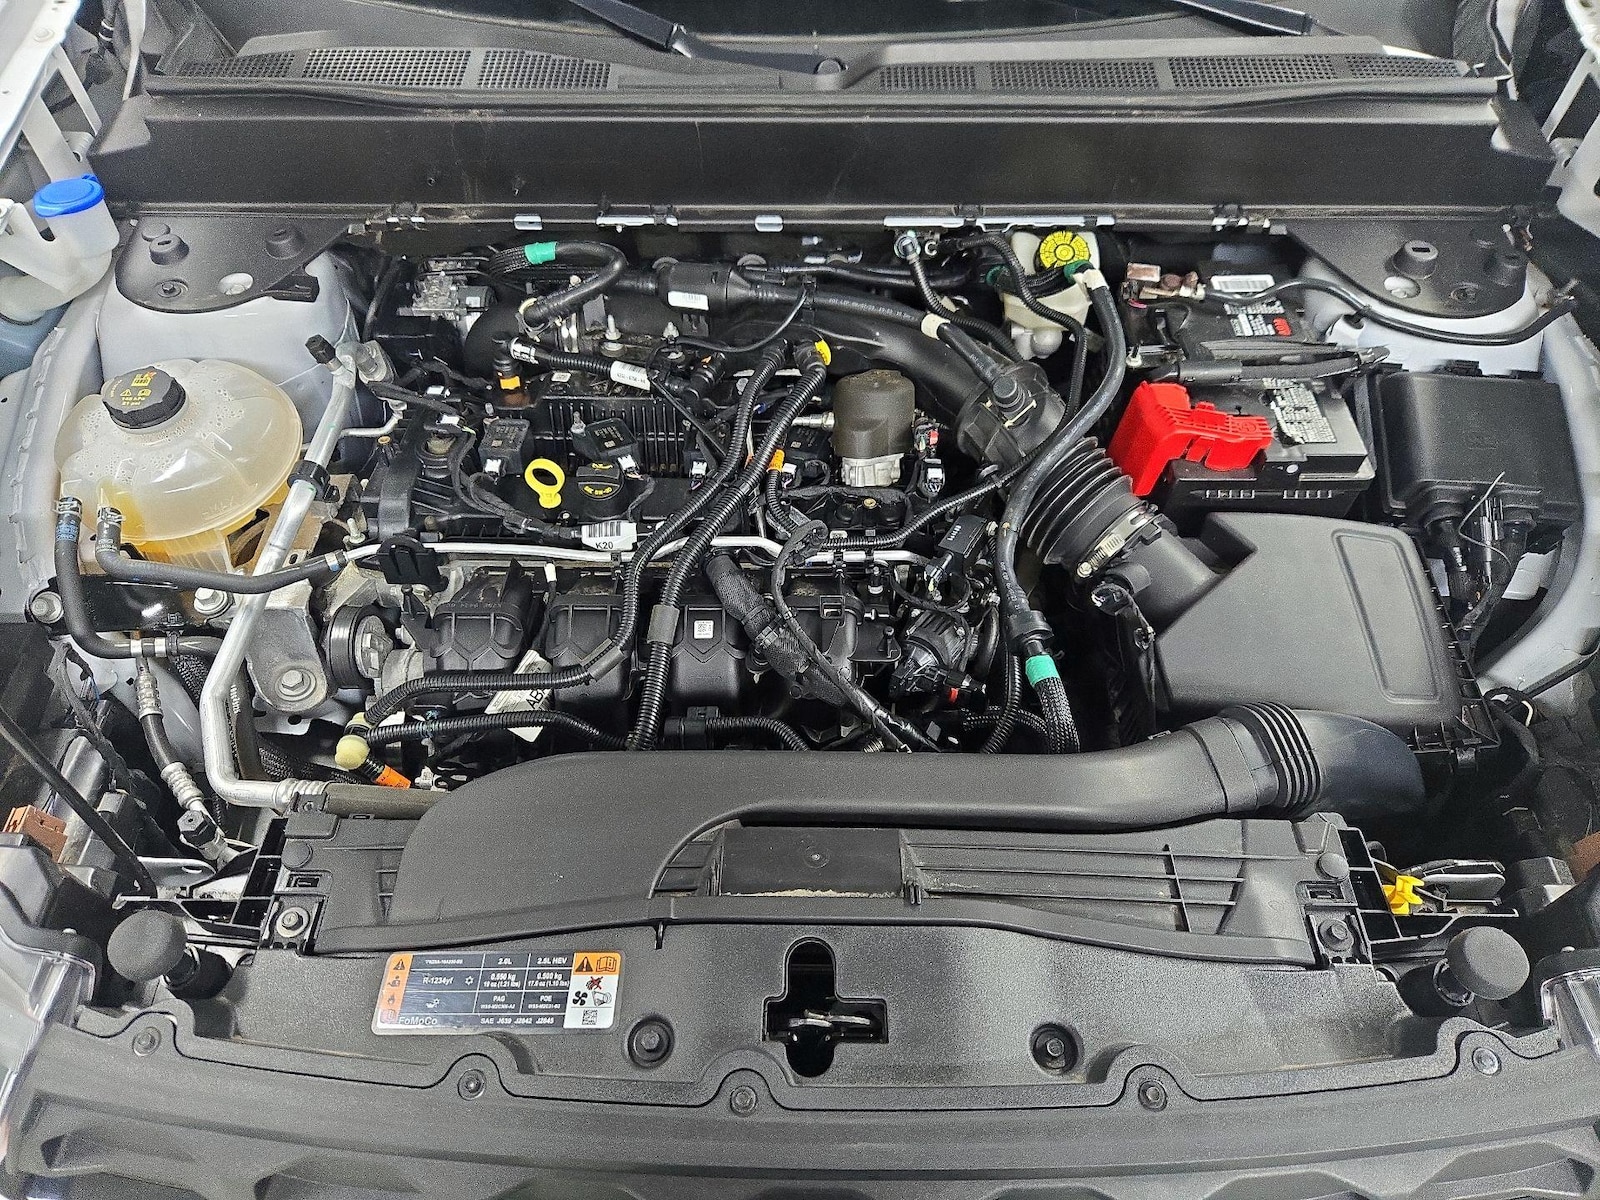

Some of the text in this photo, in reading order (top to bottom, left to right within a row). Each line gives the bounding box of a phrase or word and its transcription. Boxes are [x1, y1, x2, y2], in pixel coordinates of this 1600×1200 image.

[595, 541, 614, 549] K20
[423, 976, 455, 986] R-1234yf
[399, 1016, 438, 1025] FoMoCo
